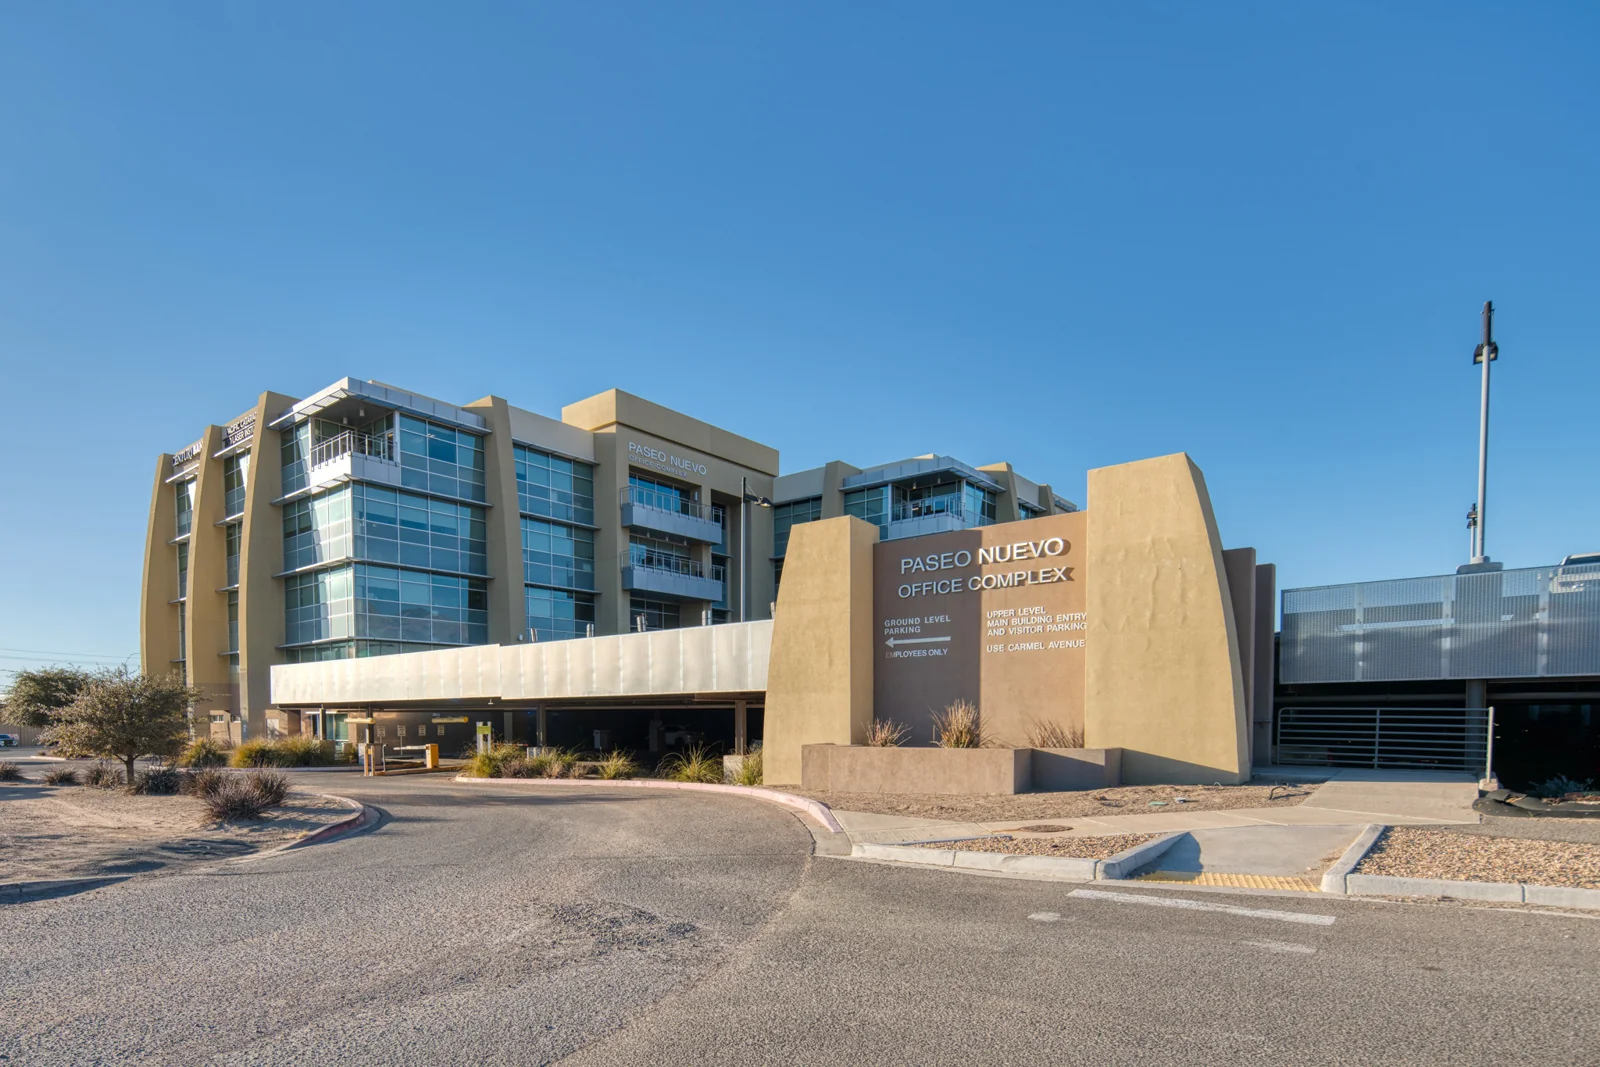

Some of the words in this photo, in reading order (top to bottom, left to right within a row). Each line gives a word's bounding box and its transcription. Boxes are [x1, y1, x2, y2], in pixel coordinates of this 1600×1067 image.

[172, 446, 193, 467] CENTURY
[628, 442, 666, 462] PASEO
[670, 456, 707, 475] NUEVO
[629, 454, 653, 467] OFFICE
[656, 463, 688, 477] COMPLEX
[901, 551, 972, 574] PASEO
[978, 537, 1064, 564] NUEVO
[898, 579, 963, 598] OFFICE
[968, 566, 1067, 591] COMPLEX
[987, 609, 1015, 619] UPPER
[1018, 606, 1046, 616] LEVEL
[884, 617, 920, 627] GROUND
[924, 615, 951, 624] LEVEL
[987, 619, 1008, 628] MAIN
[1011, 616, 1052, 626] BUILDING
[1056, 613, 1087, 622] ENTRY
[884, 626, 921, 635] PARKING
[987, 628, 1005, 637] AND
[1009, 625, 1043, 635] VISITOR
[1046, 622, 1087, 632] PARKING
[885, 649, 927, 659] EMPLOYEES
[928, 648, 948, 656] ONLY
[986, 644, 1004, 653] USE
[1008, 642, 1045, 652] CARMEL
[1048, 639, 1085, 649] AVENUE
